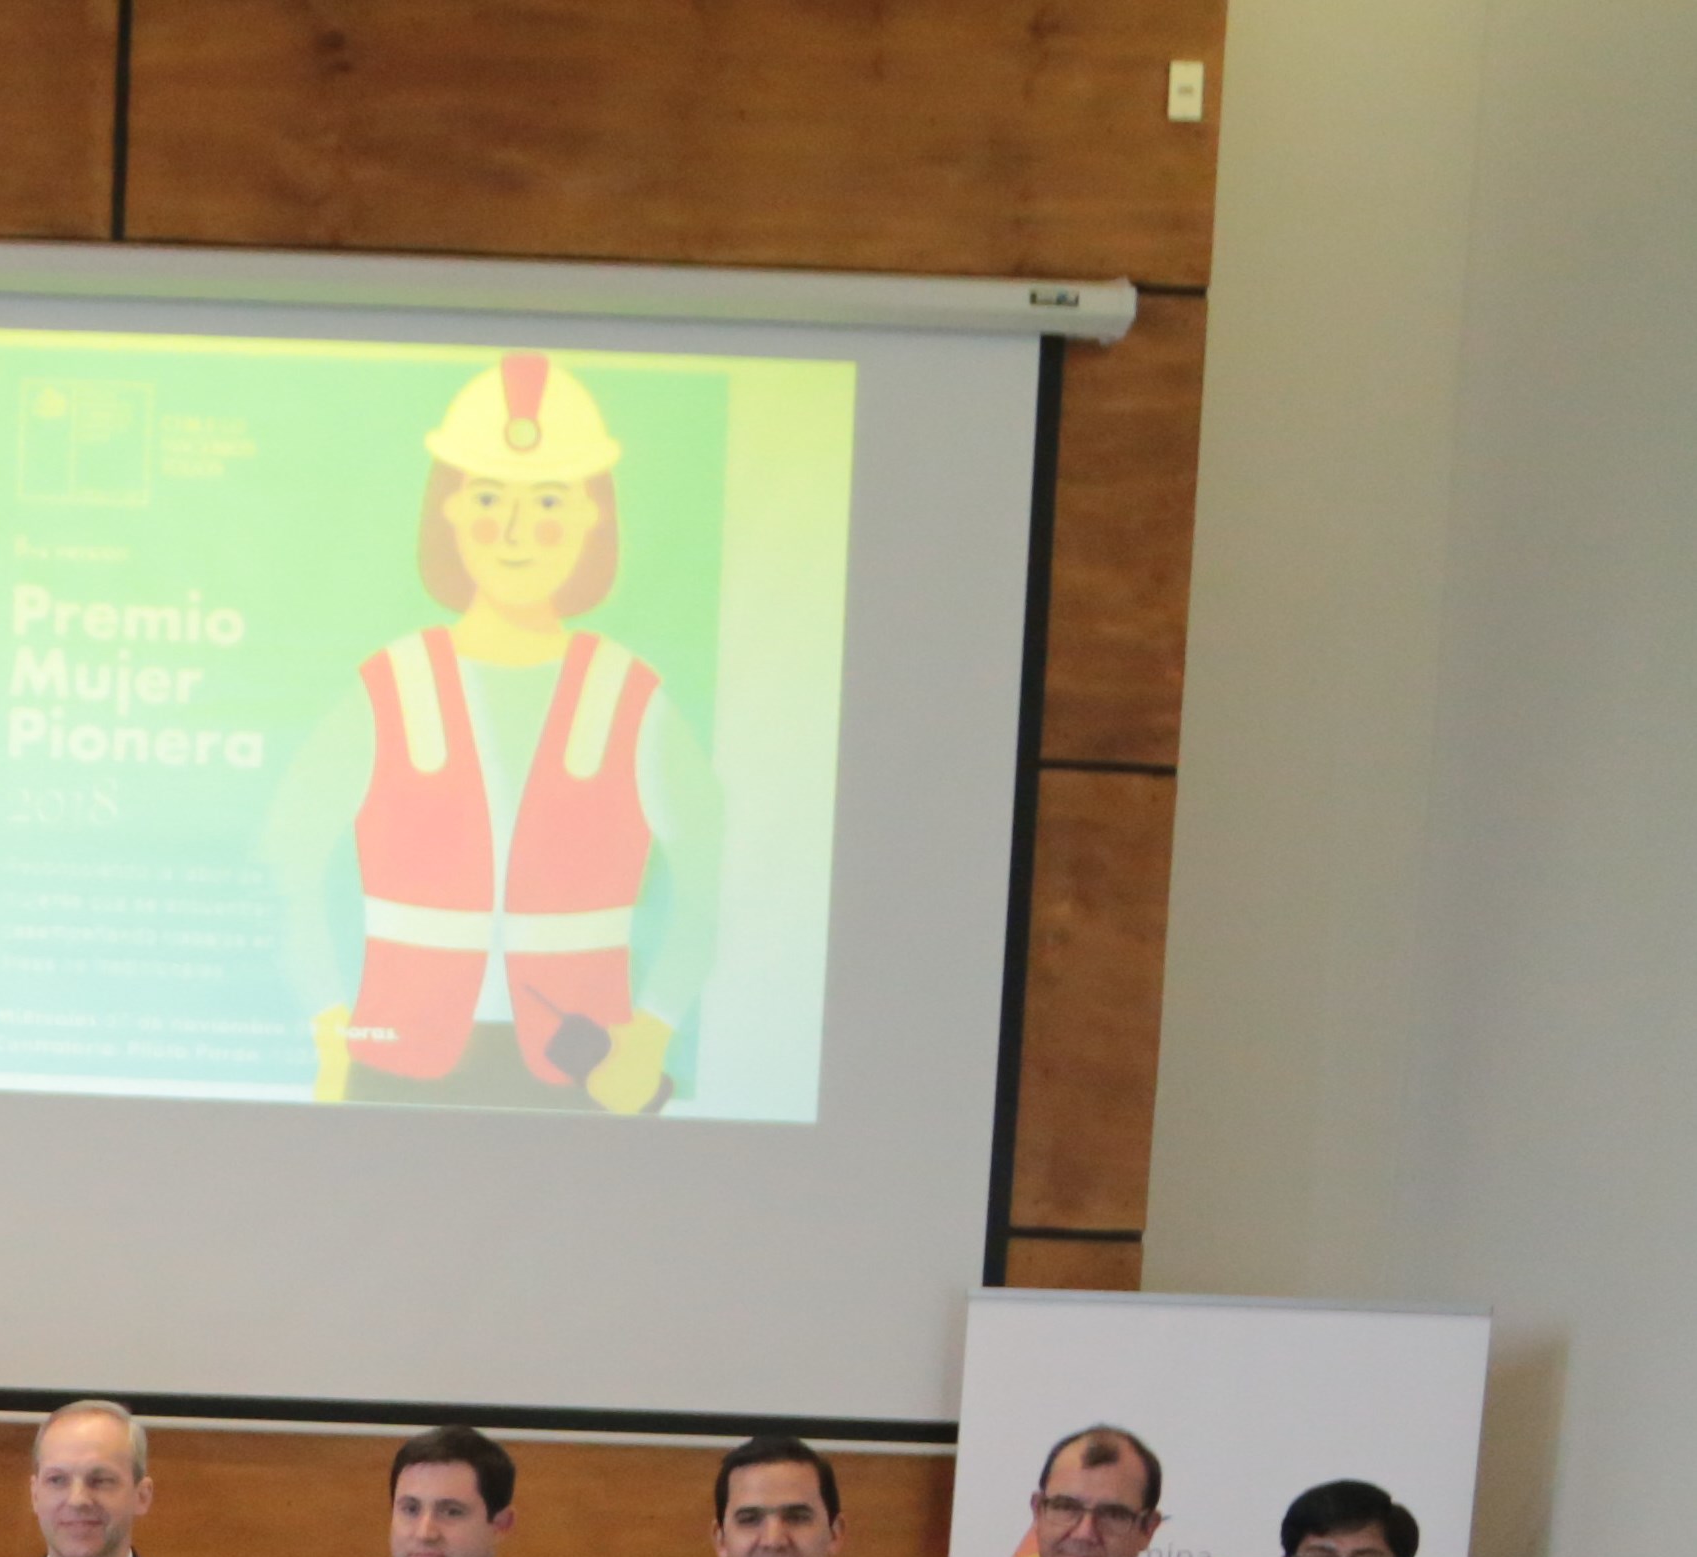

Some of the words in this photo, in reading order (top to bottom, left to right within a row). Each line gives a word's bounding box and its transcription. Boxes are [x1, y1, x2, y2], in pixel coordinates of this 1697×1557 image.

[11, 583, 245, 645] Premio
[8, 645, 203, 717] Mujer
[6, 706, 265, 769] Pionera
[6, 777, 120, 826] 2018
